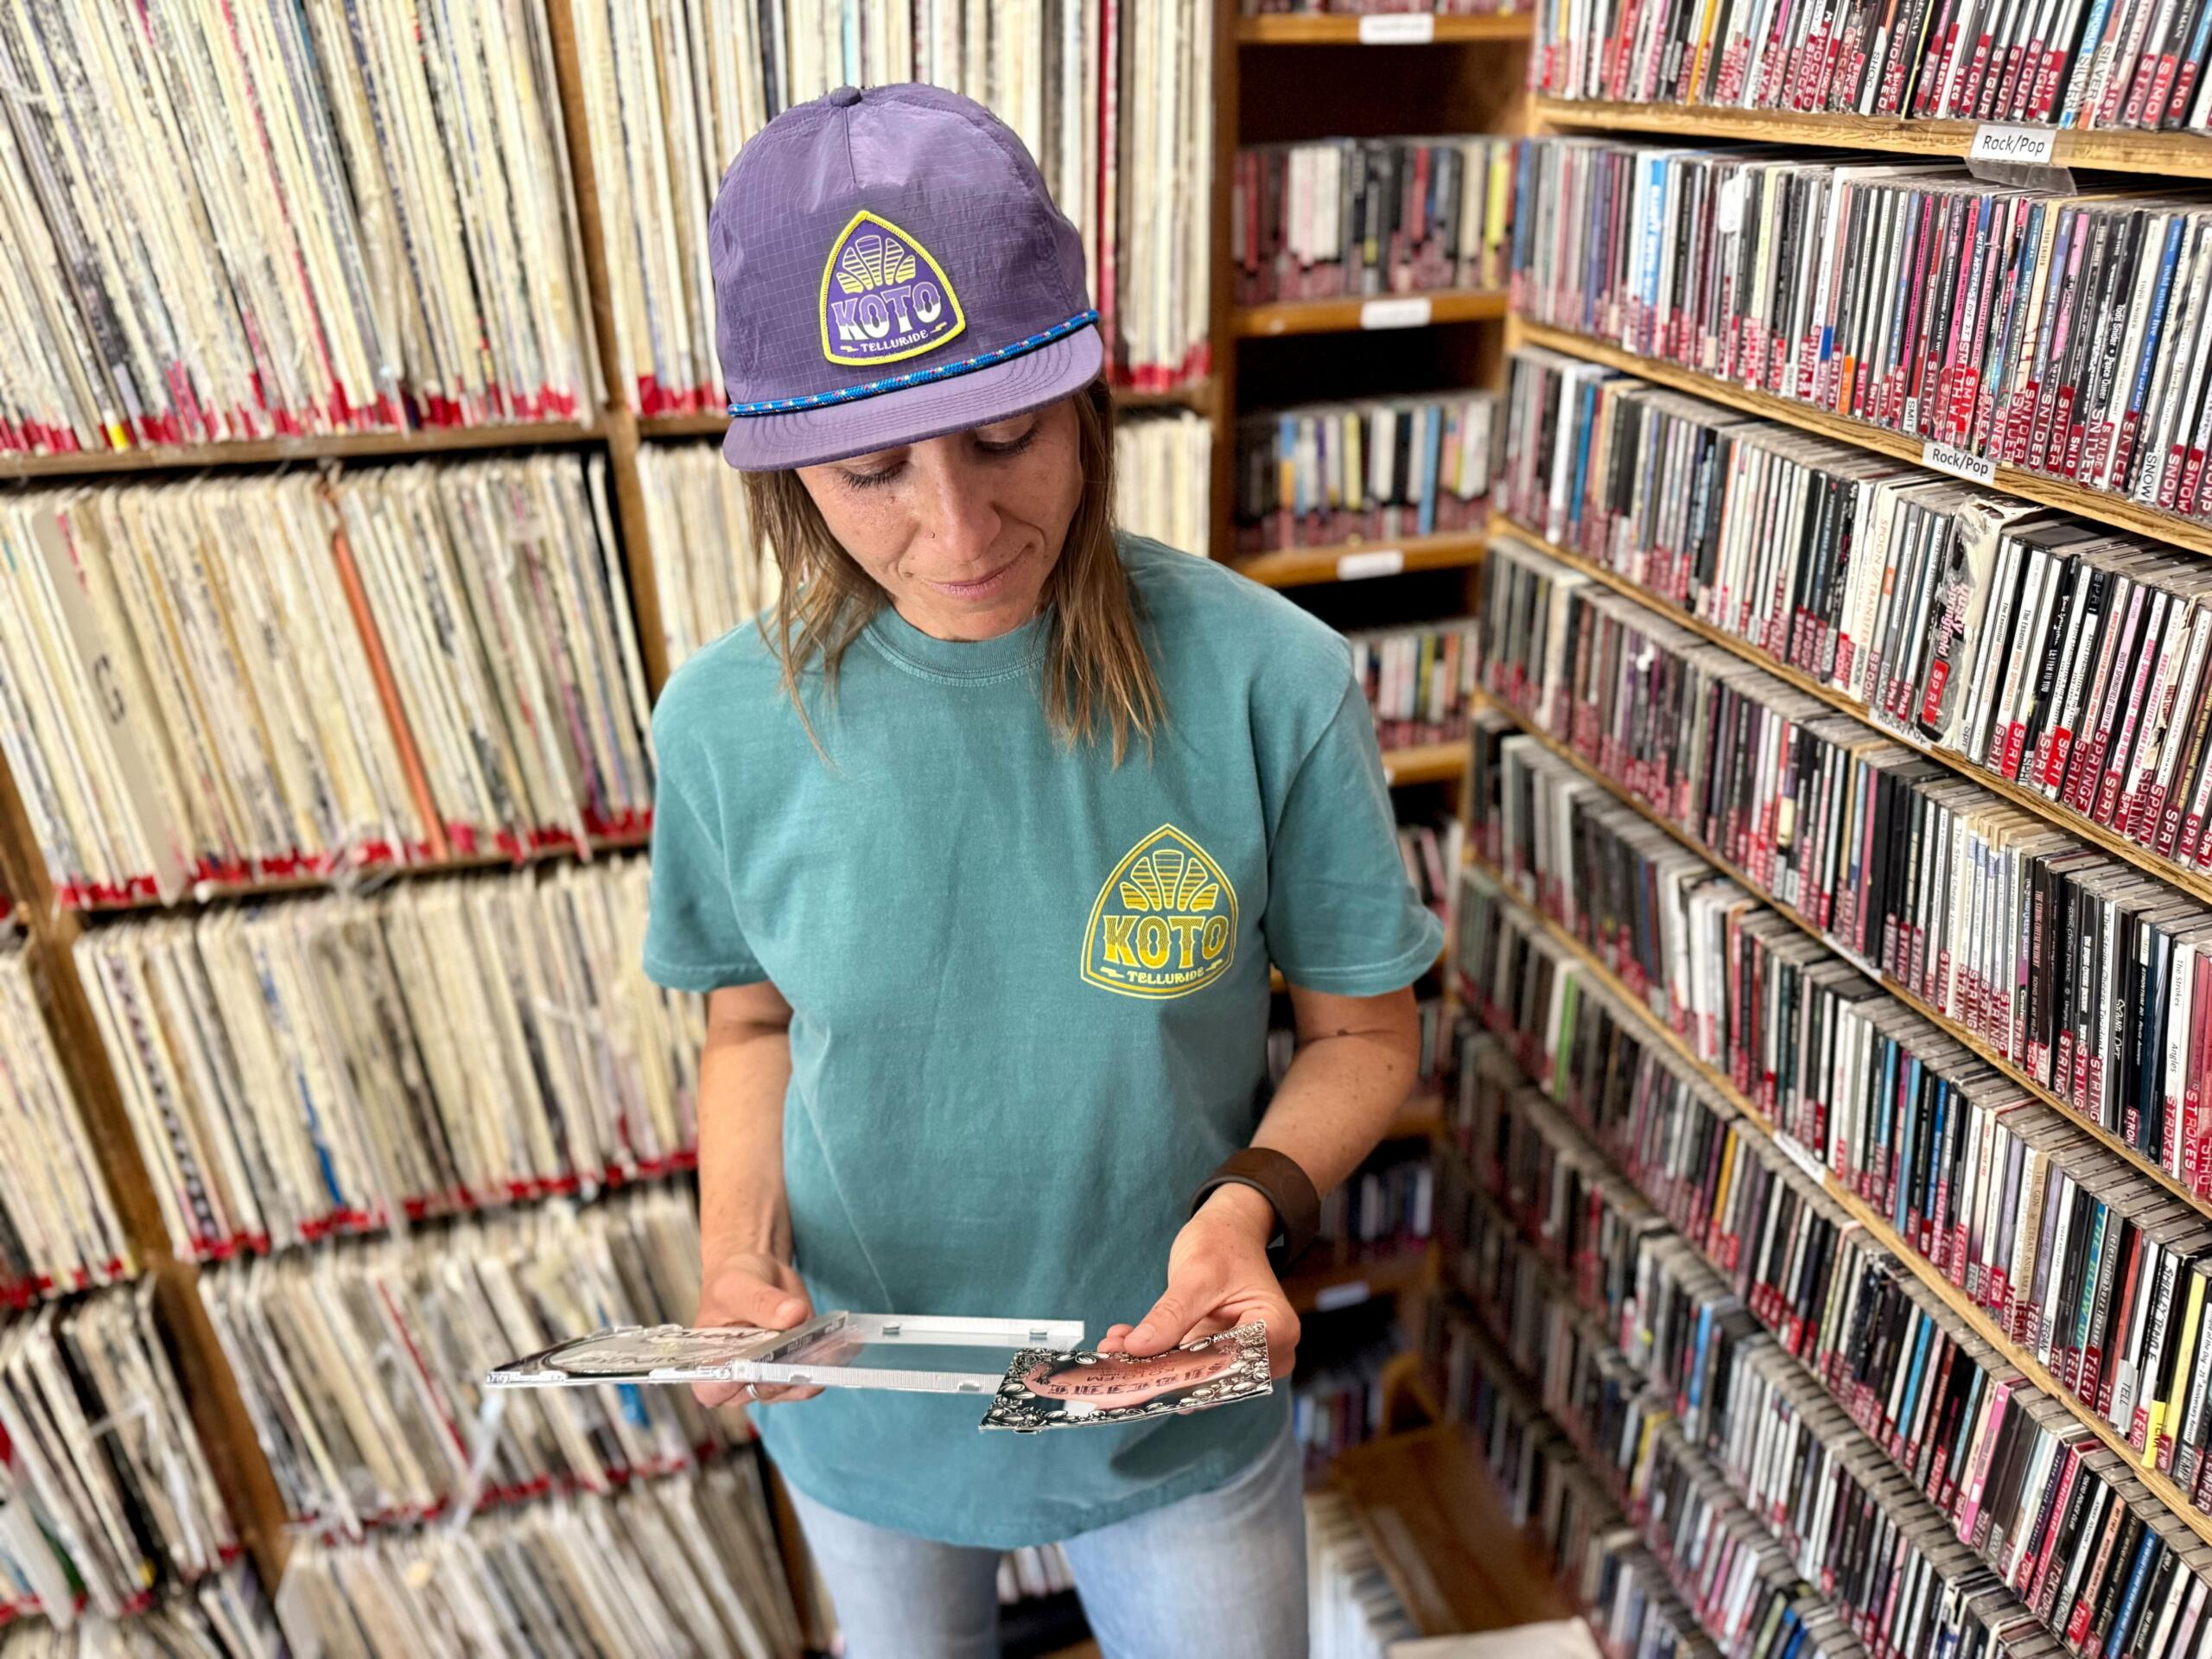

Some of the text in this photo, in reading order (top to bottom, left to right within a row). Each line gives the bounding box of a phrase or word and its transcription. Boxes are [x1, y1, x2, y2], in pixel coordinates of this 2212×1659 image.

[1795, 41, 1815, 99] SHOCK
[1802, 26, 1827, 107] SHOCKED
[1865, 51, 1879, 88] SHOC
[1877, 22, 1904, 108] SHOCKED
[1950, 67, 1965, 102] SIEG
[1961, 45, 1986, 108] SIGNA
[1978, 49, 2004, 114] SIGUR
[1994, 48, 2019, 114] SIGUR
[2014, 41, 2042, 107] SIGUR
[2028, 52, 2052, 109] SIGUR
[2066, 55, 2089, 109] SILVER
[2088, 44, 2111, 99] SILVER
[2126, 58, 2152, 115] SIMO
[2145, 60, 2171, 114] SIMO
[1982, 135, 2045, 156] Rock/Pop
[831, 281, 943, 341] KOTO
[1922, 288, 1935, 335] SMITHEREENS
[2148, 319, 2160, 336] live
[860, 329, 930, 353] TELLURIDE
[2097, 303, 2125, 400] Todd Snider Peace Queer
[1827, 351, 1840, 404] SMITH
[1891, 370, 1904, 414] SMIT
[1919, 360, 1936, 425] SMITHE
[1958, 375, 1976, 423] SMIT
[1904, 400, 1916, 430] SMIT
[1977, 395, 1993, 442] SNEA
[1988, 410, 2005, 456] SNEA
[2013, 388, 2035, 460] SNIDER
[2028, 392, 2052, 467] SNIDER
[2048, 397, 2069, 466] SNIDER
[1932, 448, 1988, 478] Rock/Pop
[2065, 435, 2080, 468] SNID
[2094, 424, 2111, 469] SNIDE
[2139, 454, 2157, 498] SNOW
[2158, 453, 2181, 504] SNOW
[2176, 460, 2199, 510] SNOW
[1860, 518, 1889, 644] SPOON TRANSFER
[1936, 583, 1962, 658] Springfield
[1995, 614, 2006, 642] Essential
[2016, 621, 2028, 650] Essential
[1853, 646, 1866, 685] SPOON
[2012, 651, 2022, 671] BRUCE
[2045, 649, 2057, 672] LETTER
[2116, 652, 2126, 670] DUSTY
[2142, 639, 2155, 662] BRUCE
[1861, 652, 1878, 700] SPOON
[1885, 681, 1897, 706] SPRA
[2002, 671, 2018, 711] SPRINGSTEEN
[2107, 670, 2121, 703] SPRINGFIELD
[2131, 663, 2148, 709] SPRINGSTEEN
[2145, 653, 2168, 723] BRUCE SPRINGSTEEN
[1897, 683, 1910, 714] SPRAG
[2125, 715, 2135, 734] BORN
[2188, 719, 2206, 766] SHALL OVERCOME
[2006, 727, 2023, 768] SPRI
[2033, 737, 2050, 779] SPRI
[2050, 737, 2069, 779] SPRI
[2076, 731, 2107, 807] SPRINGF
[2063, 739, 2085, 804] SPRING
[2097, 776, 2116, 818] SPRI
[2140, 785, 2164, 836] SPRIN
[2156, 809, 2177, 854] SPRI
[2181, 818, 2197, 852] SPRI
[1950, 849, 1960, 878] String
[1948, 879, 1958, 911] Cheese
[1103, 914, 1229, 969] KOTO
[1127, 966, 1205, 985] TELLURIDE
[1937, 952, 1948, 1007] STRING
[1954, 964, 1967, 1020] STRING
[2172, 976, 2183, 1007] Strokes
[1967, 970, 1978, 1028] STRING
[1977, 981, 1989, 1039] STRING
[1989, 988, 2001, 1046] STRING
[1999, 994, 2009, 1051] STRING
[2013, 1019, 2023, 1058] STRING
[2096, 1008, 2106, 1049] Incident
[2025, 1046, 2036, 1071] SCI
[2055, 1035, 2069, 1094] STRING
[2073, 1046, 2087, 1109] STRING
[2169, 1042, 2179, 1072] Angles
[2088, 1058, 2101, 1121] STRING
[2125, 1109, 2137, 1142] STRON
[2161, 1095, 2177, 1168] STROKES
[2183, 1090, 2197, 1169] STROKES
[2031, 1190, 2041, 1207] CON
[2024, 1224, 2036, 1252] TEGAN
[2091, 1211, 2106, 1251] THE
[1950, 1225, 1965, 1285] TEENAGE
[2022, 1255, 2031, 1273] AND
[1967, 1265, 1977, 1292] TEEN
[1976, 1264, 1989, 1302] TEENA
[1991, 1274, 2002, 1301] TEGA
[2001, 1289, 2015, 1331] TEGAN
[2012, 1300, 2025, 1343] TEGAN
[2024, 1304, 2038, 1347] TEGAN
[2146, 1264, 2175, 1361] SHIRLEY TEMPLE
[2039, 1318, 2051, 1351] TEGAN
[2050, 1347, 2062, 1376] TELE
[2065, 1351, 2078, 1386] TELE
[2080, 1354, 2095, 1400] TELEV
[2097, 1382, 2109, 1419] TELE
[2120, 1382, 2130, 1406] TELL
[2190, 1382, 2203, 1419] Anniversary
[2131, 1409, 2145, 1446] TEMP
[2186, 1419, 2196, 1442] Reissue
[2158, 1439, 2169, 1468] TEMP
[2068, 1473, 2090, 1530] TOKYO POLICE CLUB
[1972, 1510, 1988, 1546] TOBIN
[2037, 1564, 2063, 1618] TOKYOPO
[2053, 1591, 2071, 1627] TOLCHIN
